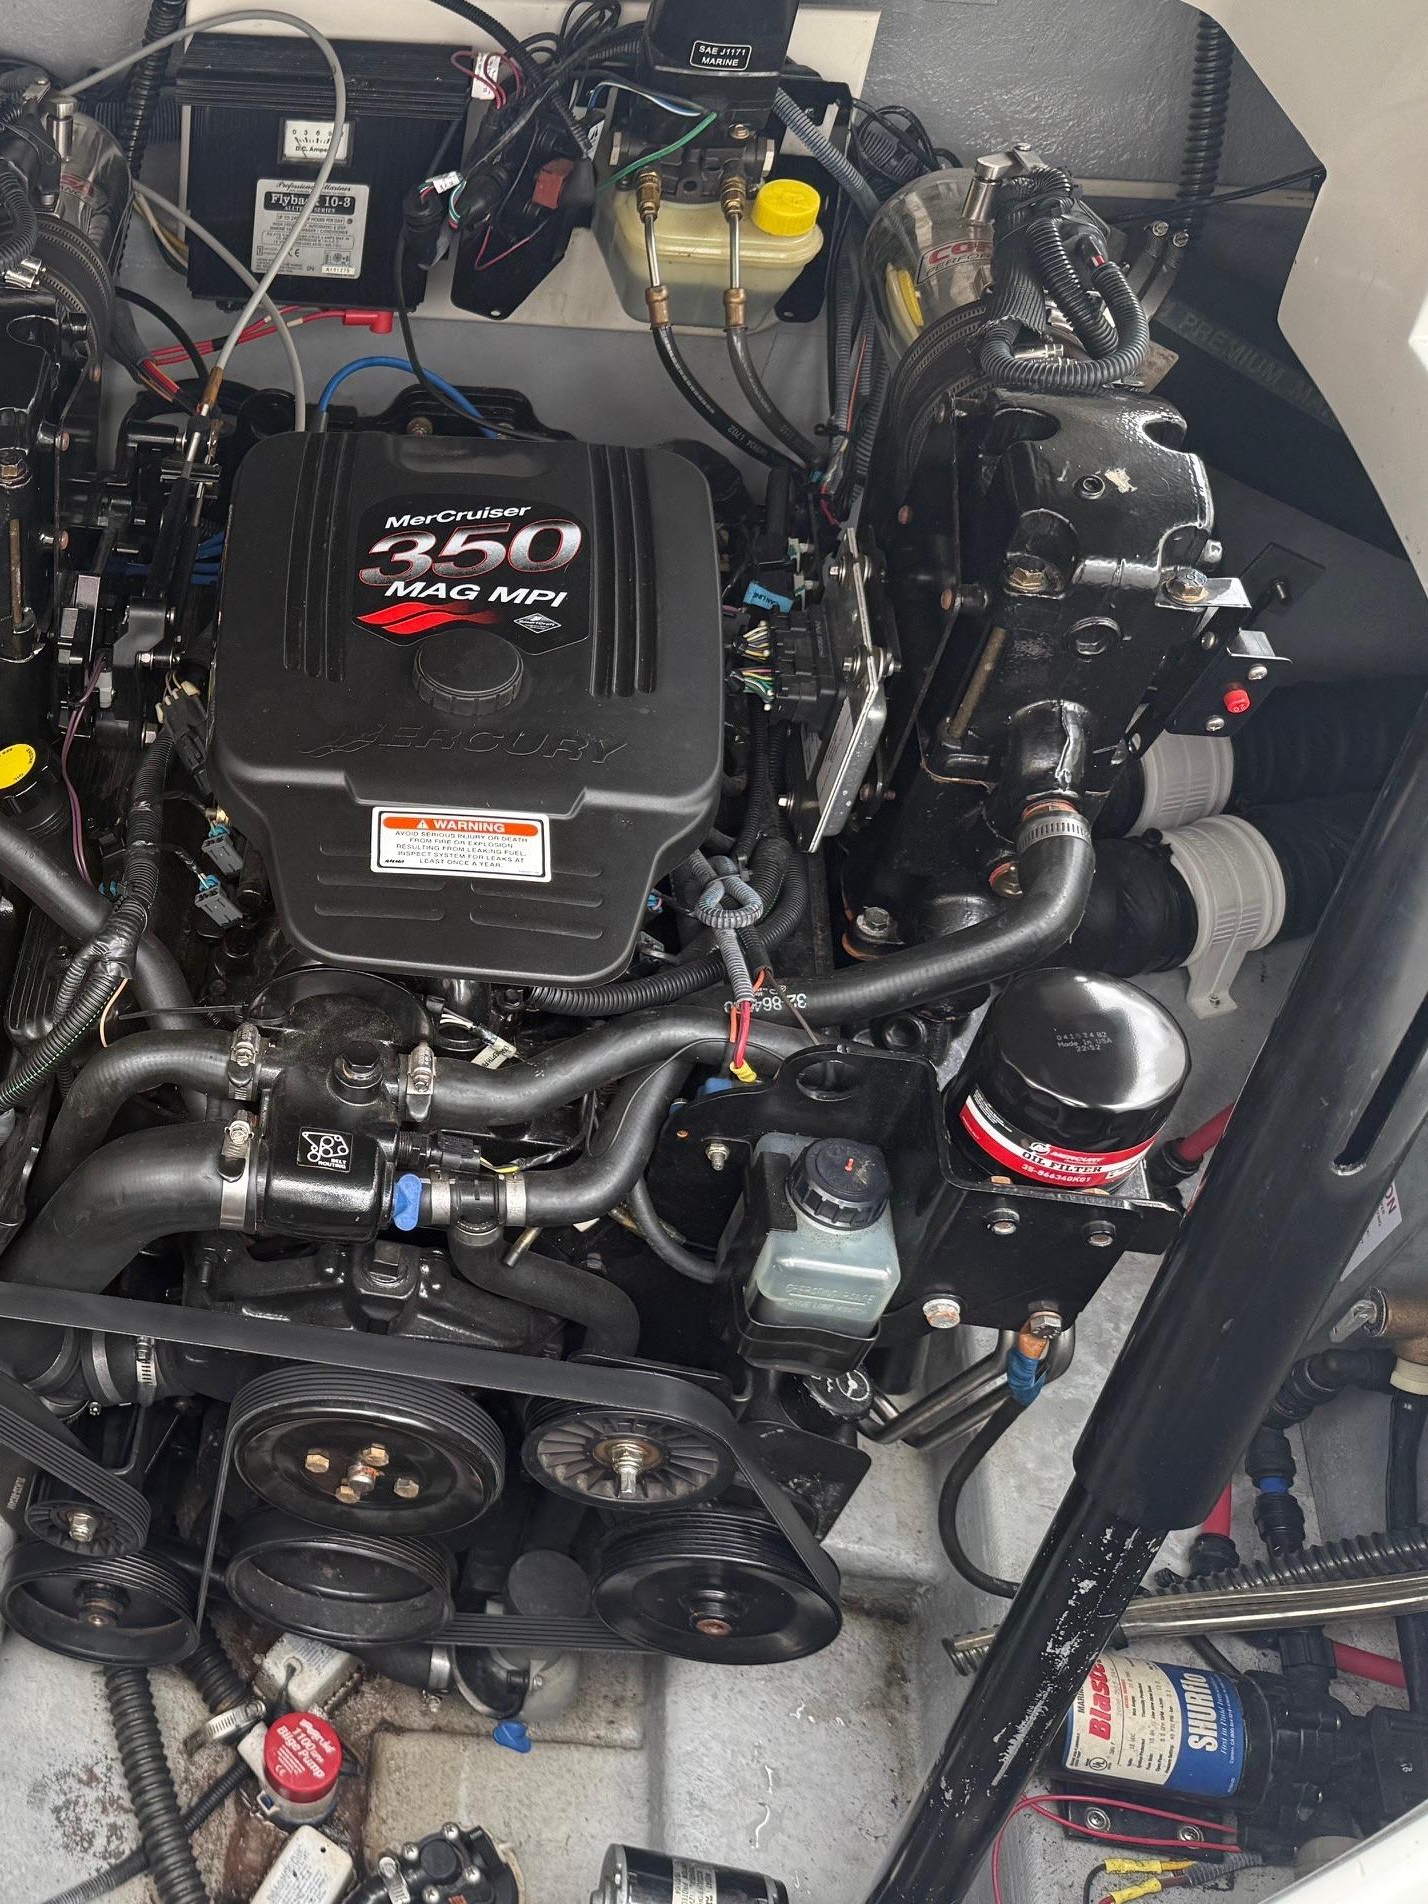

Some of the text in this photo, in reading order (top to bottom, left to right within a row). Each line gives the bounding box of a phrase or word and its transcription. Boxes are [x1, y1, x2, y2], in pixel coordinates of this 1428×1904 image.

[699, 46, 718, 54] SAE
[702, 57, 738, 66] MARINE
[271, 193, 320, 206] Flybak
[384, 506, 532, 529] MerCruiser
[358, 518, 583, 587] 350
[384, 580, 568, 608] MAG MPI
[433, 819, 505, 833] WARNING
[421, 831, 455, 839] SERIOUS
[466, 846, 502, 854] LEAKING
[467, 840, 513, 849] EXPLOSION
[486, 854, 513, 862] LEAKS
[1057, 1040, 1079, 1048] Made
[1096, 1037, 1112, 1045] USA
[1022, 1151, 1046, 1166] OIL
[1050, 1160, 1102, 1173] FILTER
[1180, 1673, 1219, 1752] SHURflo
[292, 1727, 316, 1751] 1100
[276, 1725, 301, 1752] Bilge
[298, 1749, 326, 1779] Pump
